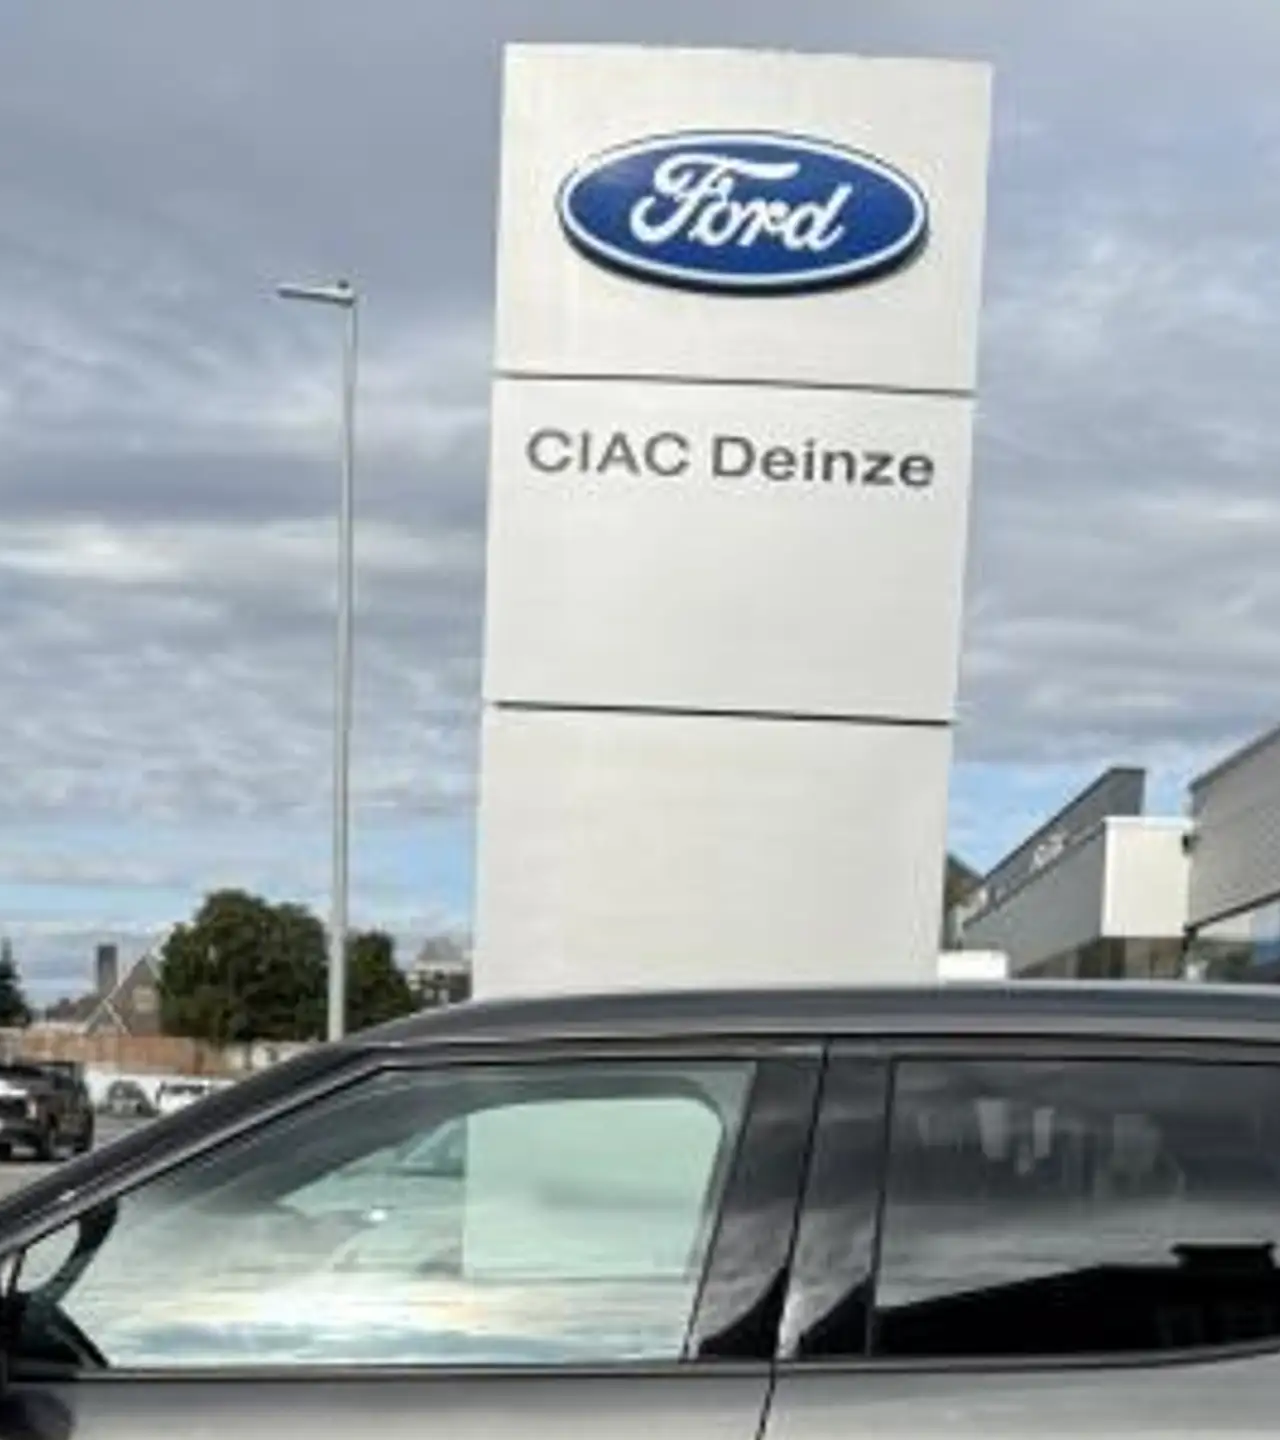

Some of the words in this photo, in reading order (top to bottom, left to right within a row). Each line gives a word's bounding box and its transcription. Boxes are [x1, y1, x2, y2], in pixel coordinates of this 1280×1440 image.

[629, 152, 852, 252] Ford
[526, 429, 690, 478] CIAC
[711, 436, 936, 488] Deinze
